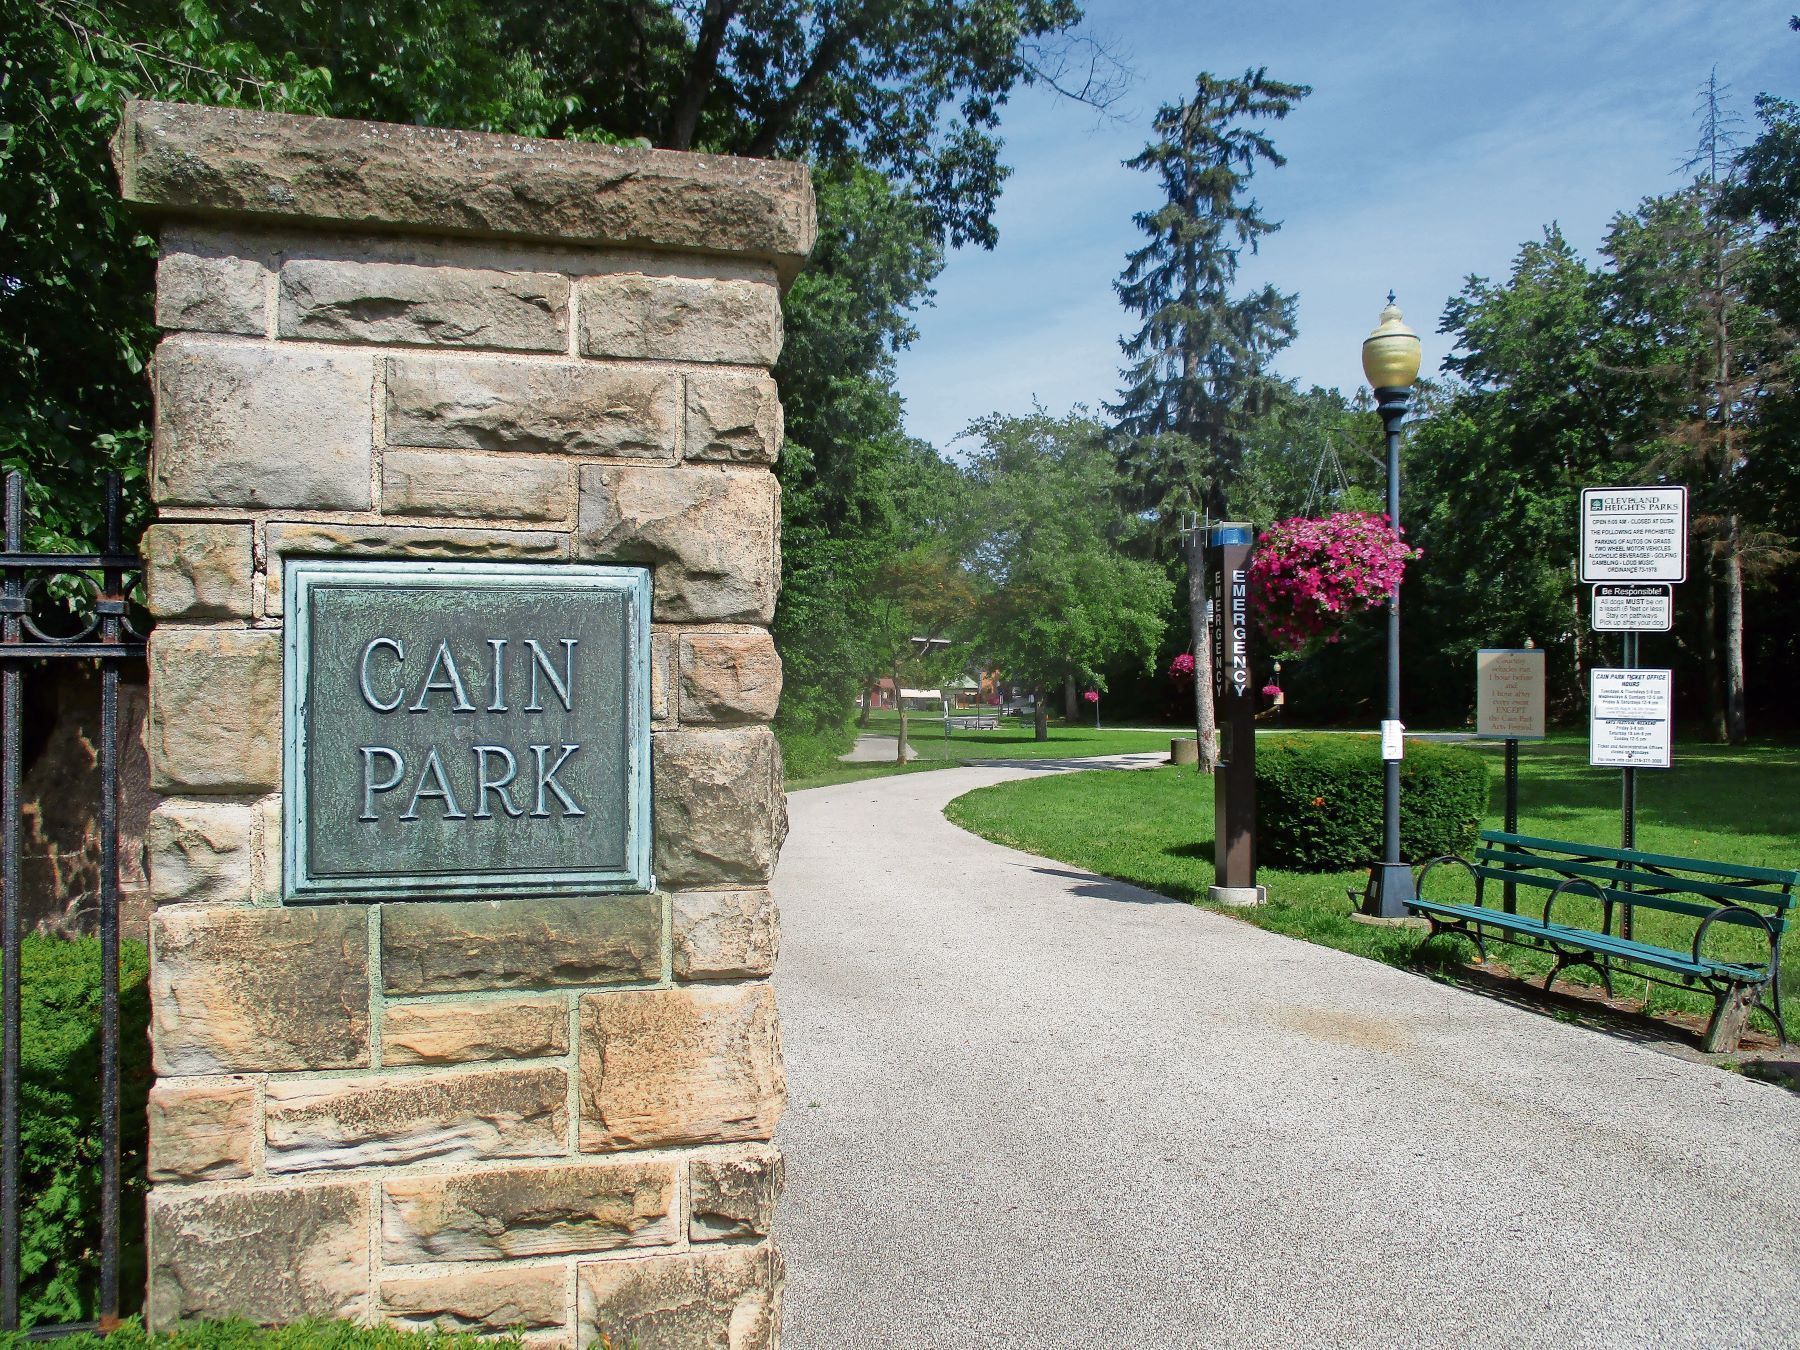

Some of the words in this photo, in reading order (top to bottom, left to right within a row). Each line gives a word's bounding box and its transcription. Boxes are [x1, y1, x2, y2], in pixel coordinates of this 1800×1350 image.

[1605, 497, 1660, 505] CLEVELAND
[1605, 503, 1646, 512] HEIGHTS
[1649, 503, 1679, 511] PARKS
[1614, 587, 1662, 596] Responsible!
[1233, 569, 1247, 697] EMERGENCY
[360, 637, 578, 713] CAIN
[358, 744, 585, 822] PARK
